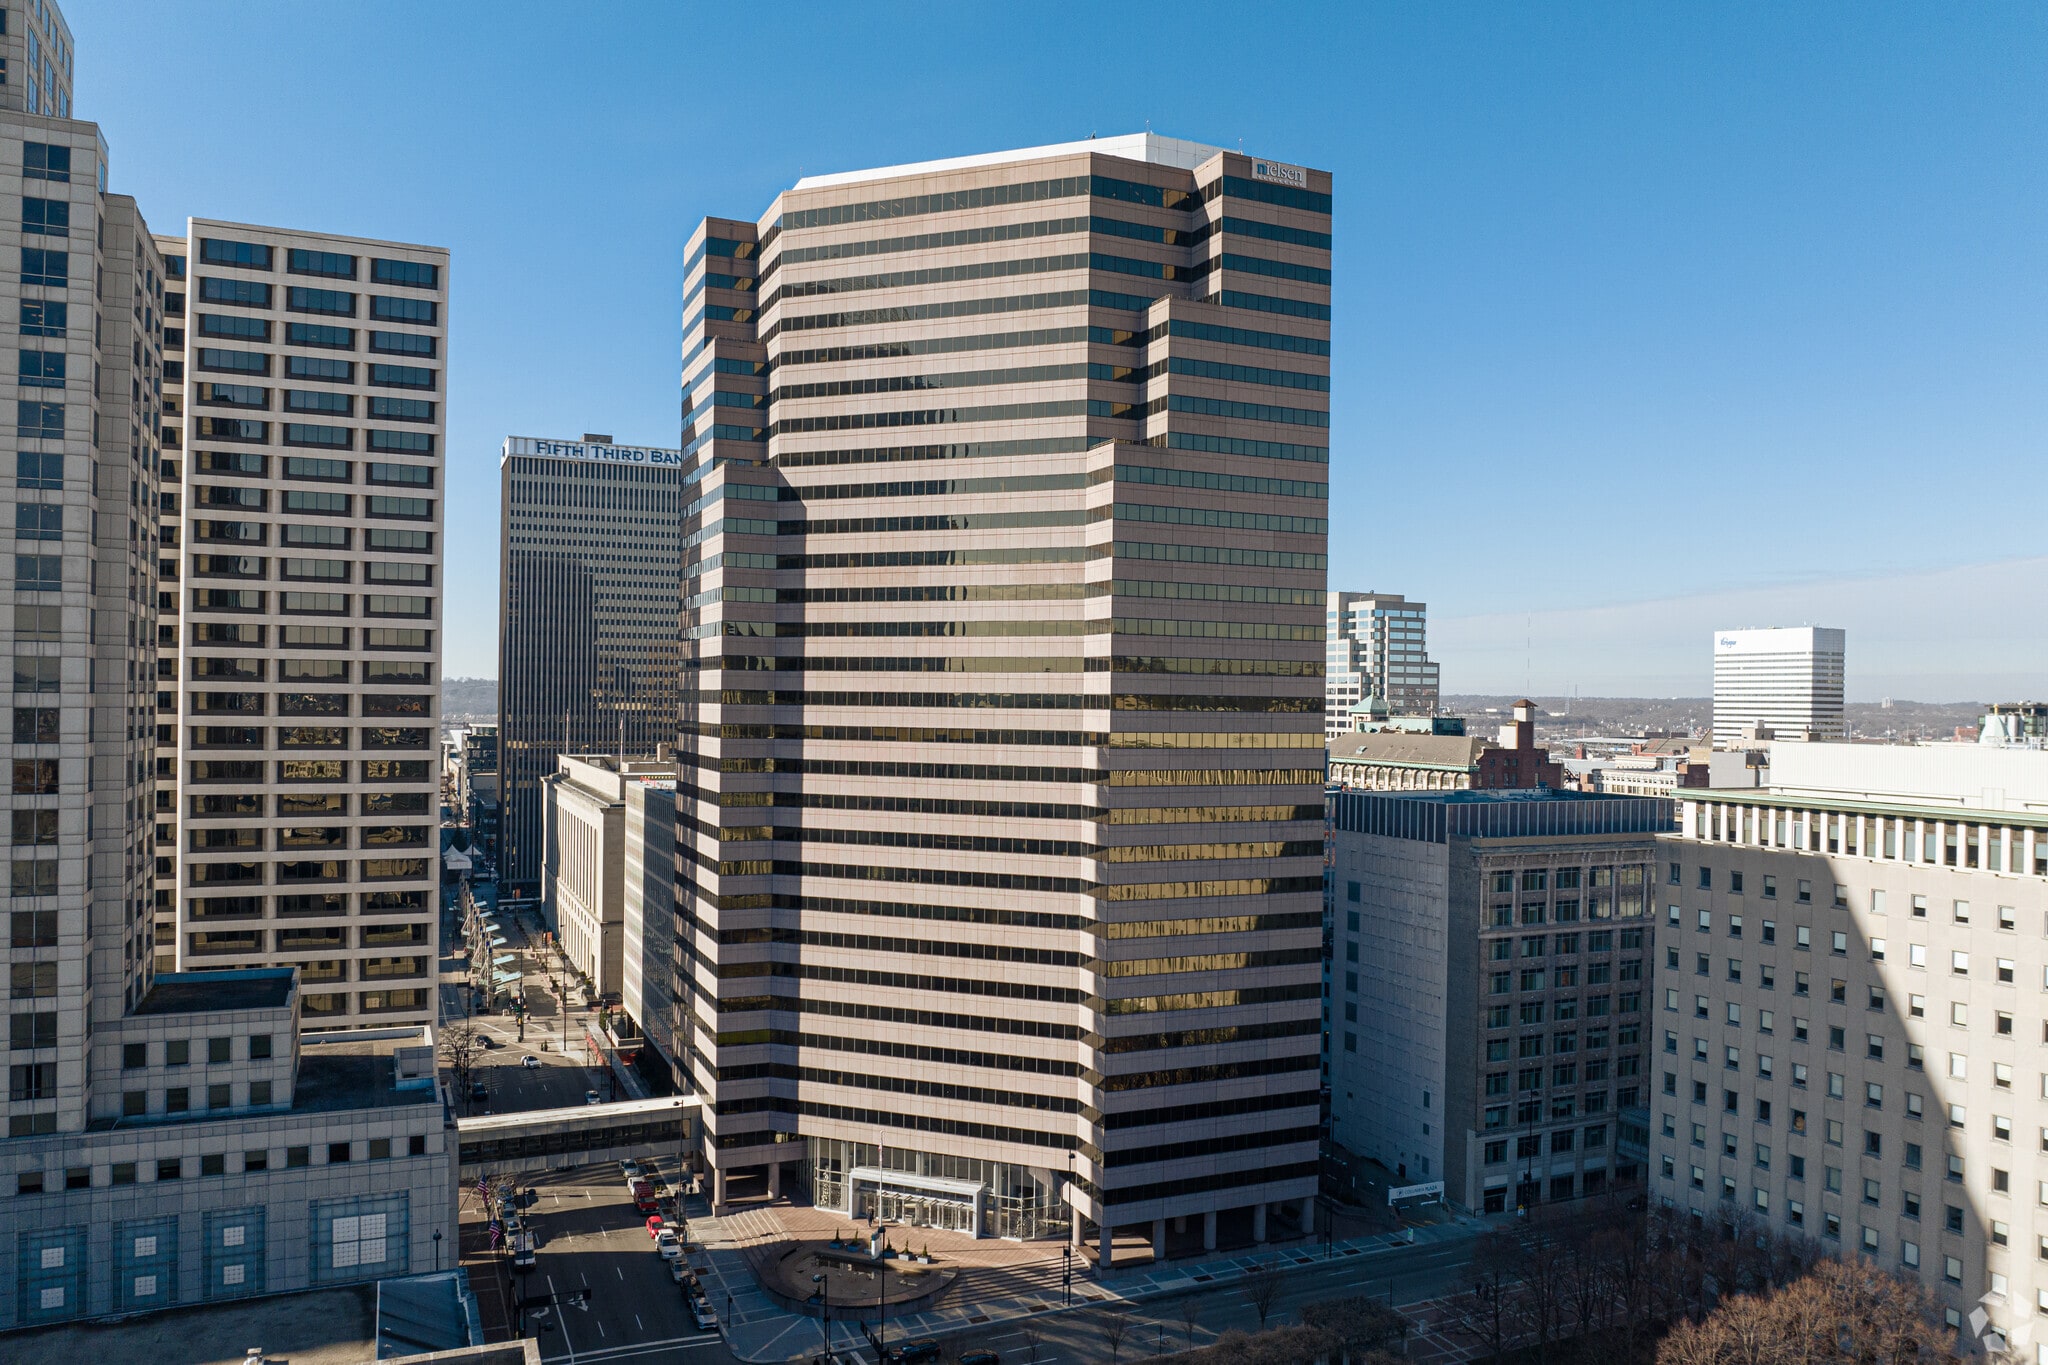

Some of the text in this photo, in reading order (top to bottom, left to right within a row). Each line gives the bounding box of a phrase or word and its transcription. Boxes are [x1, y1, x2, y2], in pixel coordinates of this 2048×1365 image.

[1257, 161, 1302, 182] nielsen
[536, 441, 682, 464] FIFTH THIRD BAN
